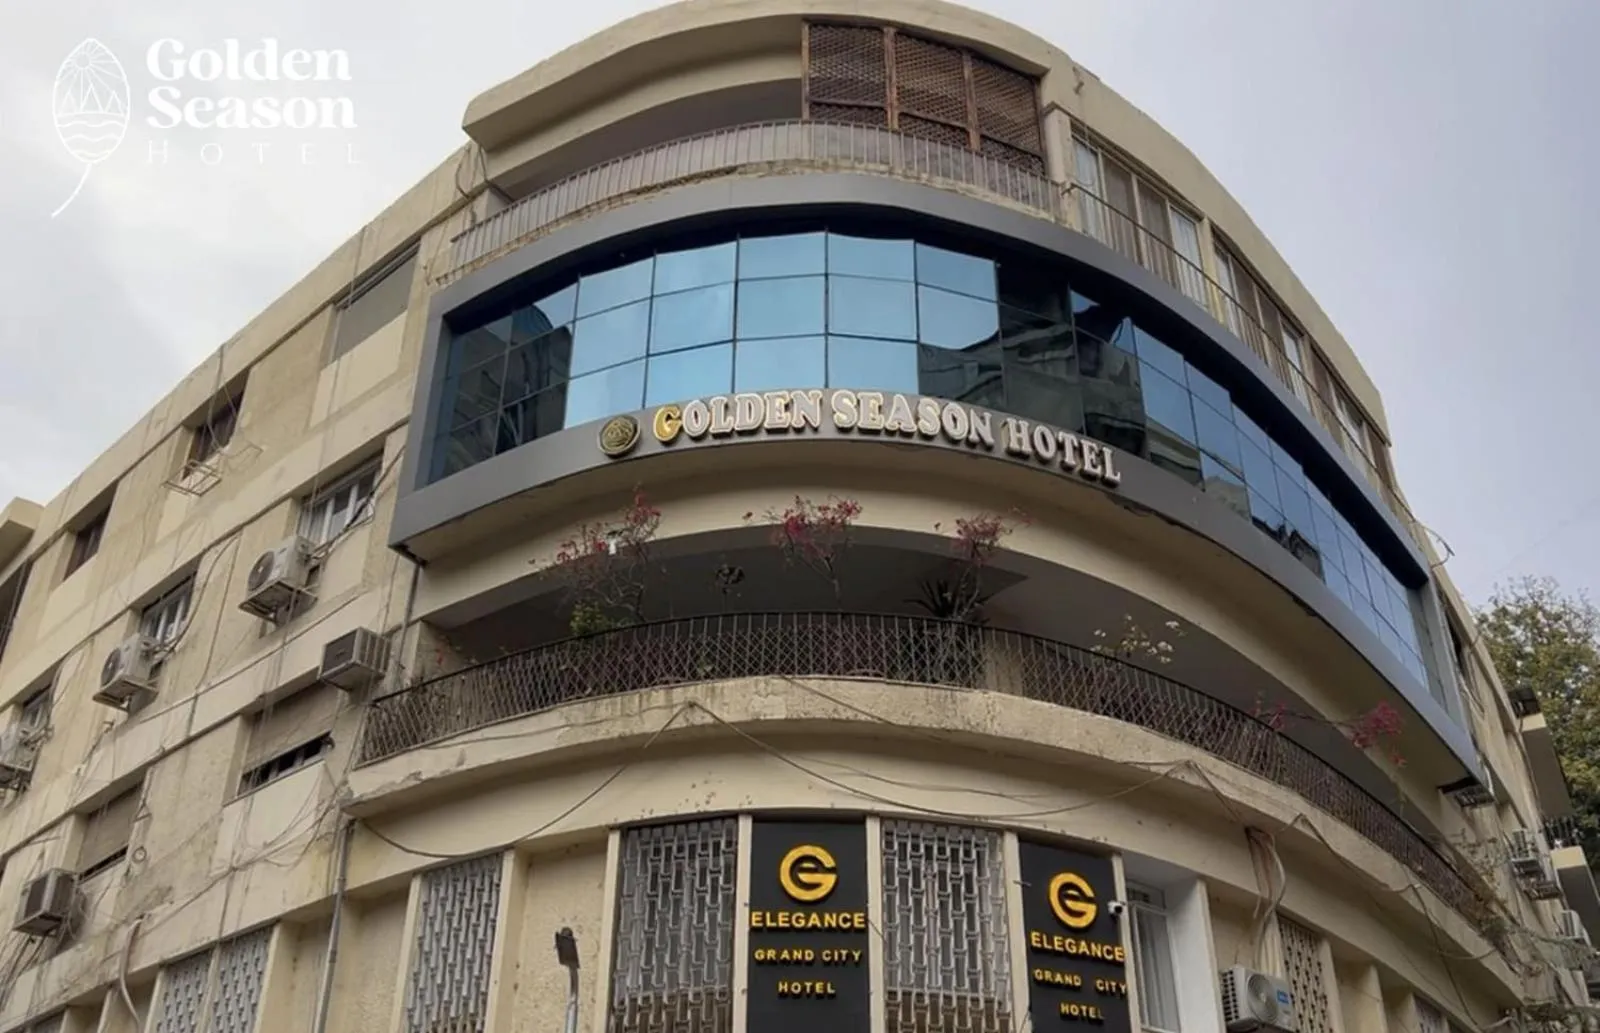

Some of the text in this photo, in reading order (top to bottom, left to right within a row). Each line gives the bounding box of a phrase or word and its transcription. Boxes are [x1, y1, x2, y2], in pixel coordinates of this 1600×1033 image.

[653, 389, 1121, 481] GOLDEN SEASON HOTEL
[751, 911, 866, 929] ELEGANCE
[754, 949, 863, 962] GRAND CITY
[1030, 931, 1125, 963] ELEGANCE
[777, 982, 836, 994] HOTEL
[1034, 969, 1127, 995] GRAND CITY
[1060, 1002, 1105, 1020] HOTEL
